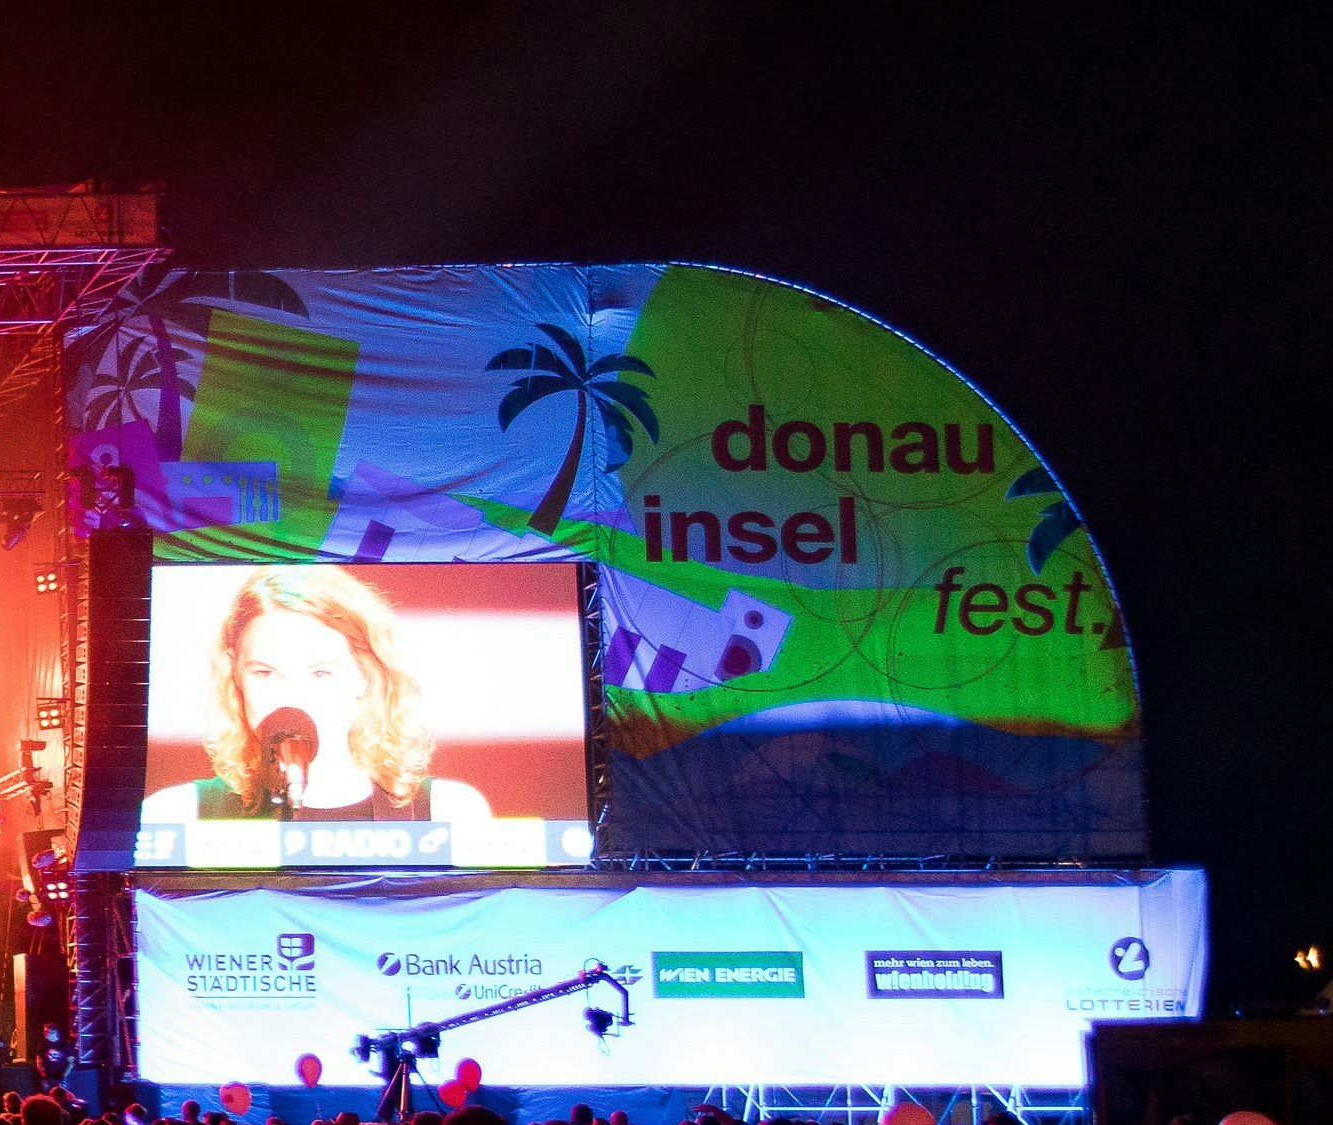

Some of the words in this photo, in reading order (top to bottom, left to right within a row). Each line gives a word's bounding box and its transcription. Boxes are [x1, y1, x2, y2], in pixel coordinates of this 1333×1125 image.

[710, 404, 996, 475] donau
[643, 494, 859, 565] insel
[932, 565, 1106, 637] fest.
[311, 829, 412, 859] RADIO
[185, 954, 273, 971] WIENER
[405, 953, 462, 976] Bank
[467, 953, 542, 976] Austria
[873, 957, 904, 967] mehr
[906, 957, 934, 967] wien
[935, 959, 960, 967] zum
[961, 957, 994, 967] leben.
[187, 975, 317, 992] STÄDTISCHE
[715, 967, 796, 983] ENERGIE
[875, 970, 994, 993] wienholding
